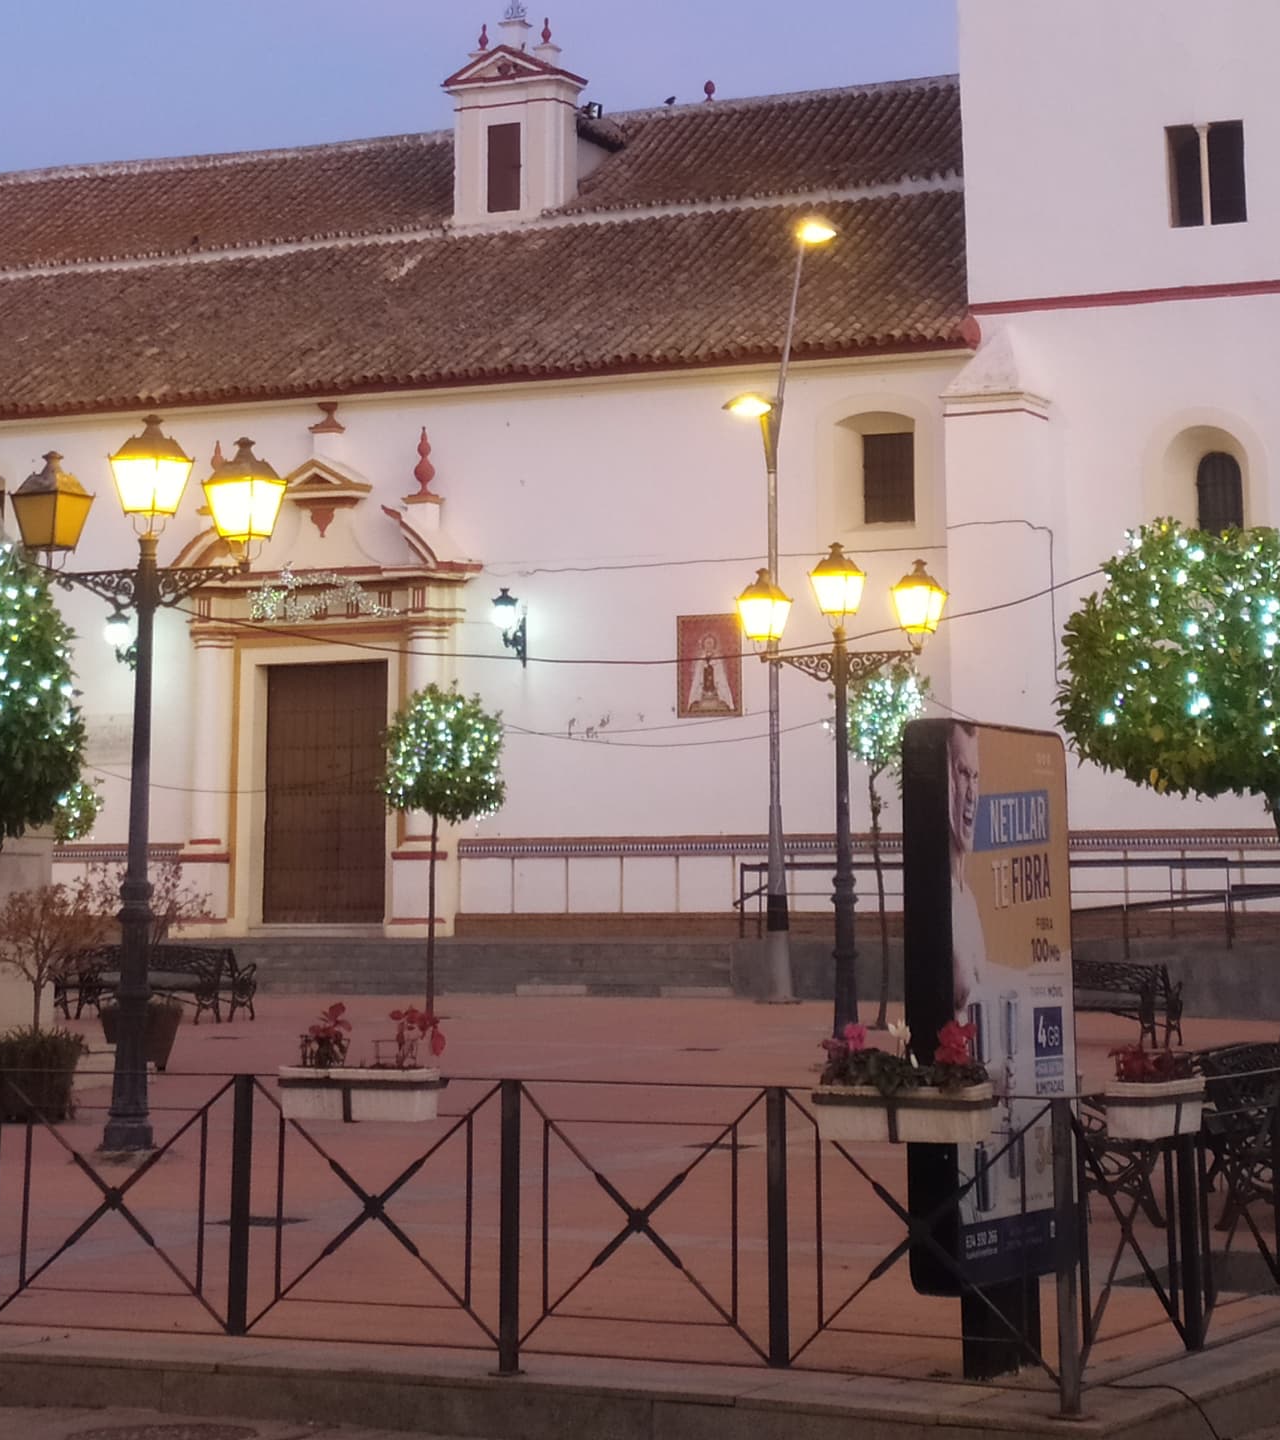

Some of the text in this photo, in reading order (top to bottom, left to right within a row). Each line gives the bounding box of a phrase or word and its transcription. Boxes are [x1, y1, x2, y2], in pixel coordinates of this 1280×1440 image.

[990, 795, 1047, 844] NETLLAR
[992, 853, 1051, 909] TE FIBRA
[1036, 917, 1053, 930] FIBRA
